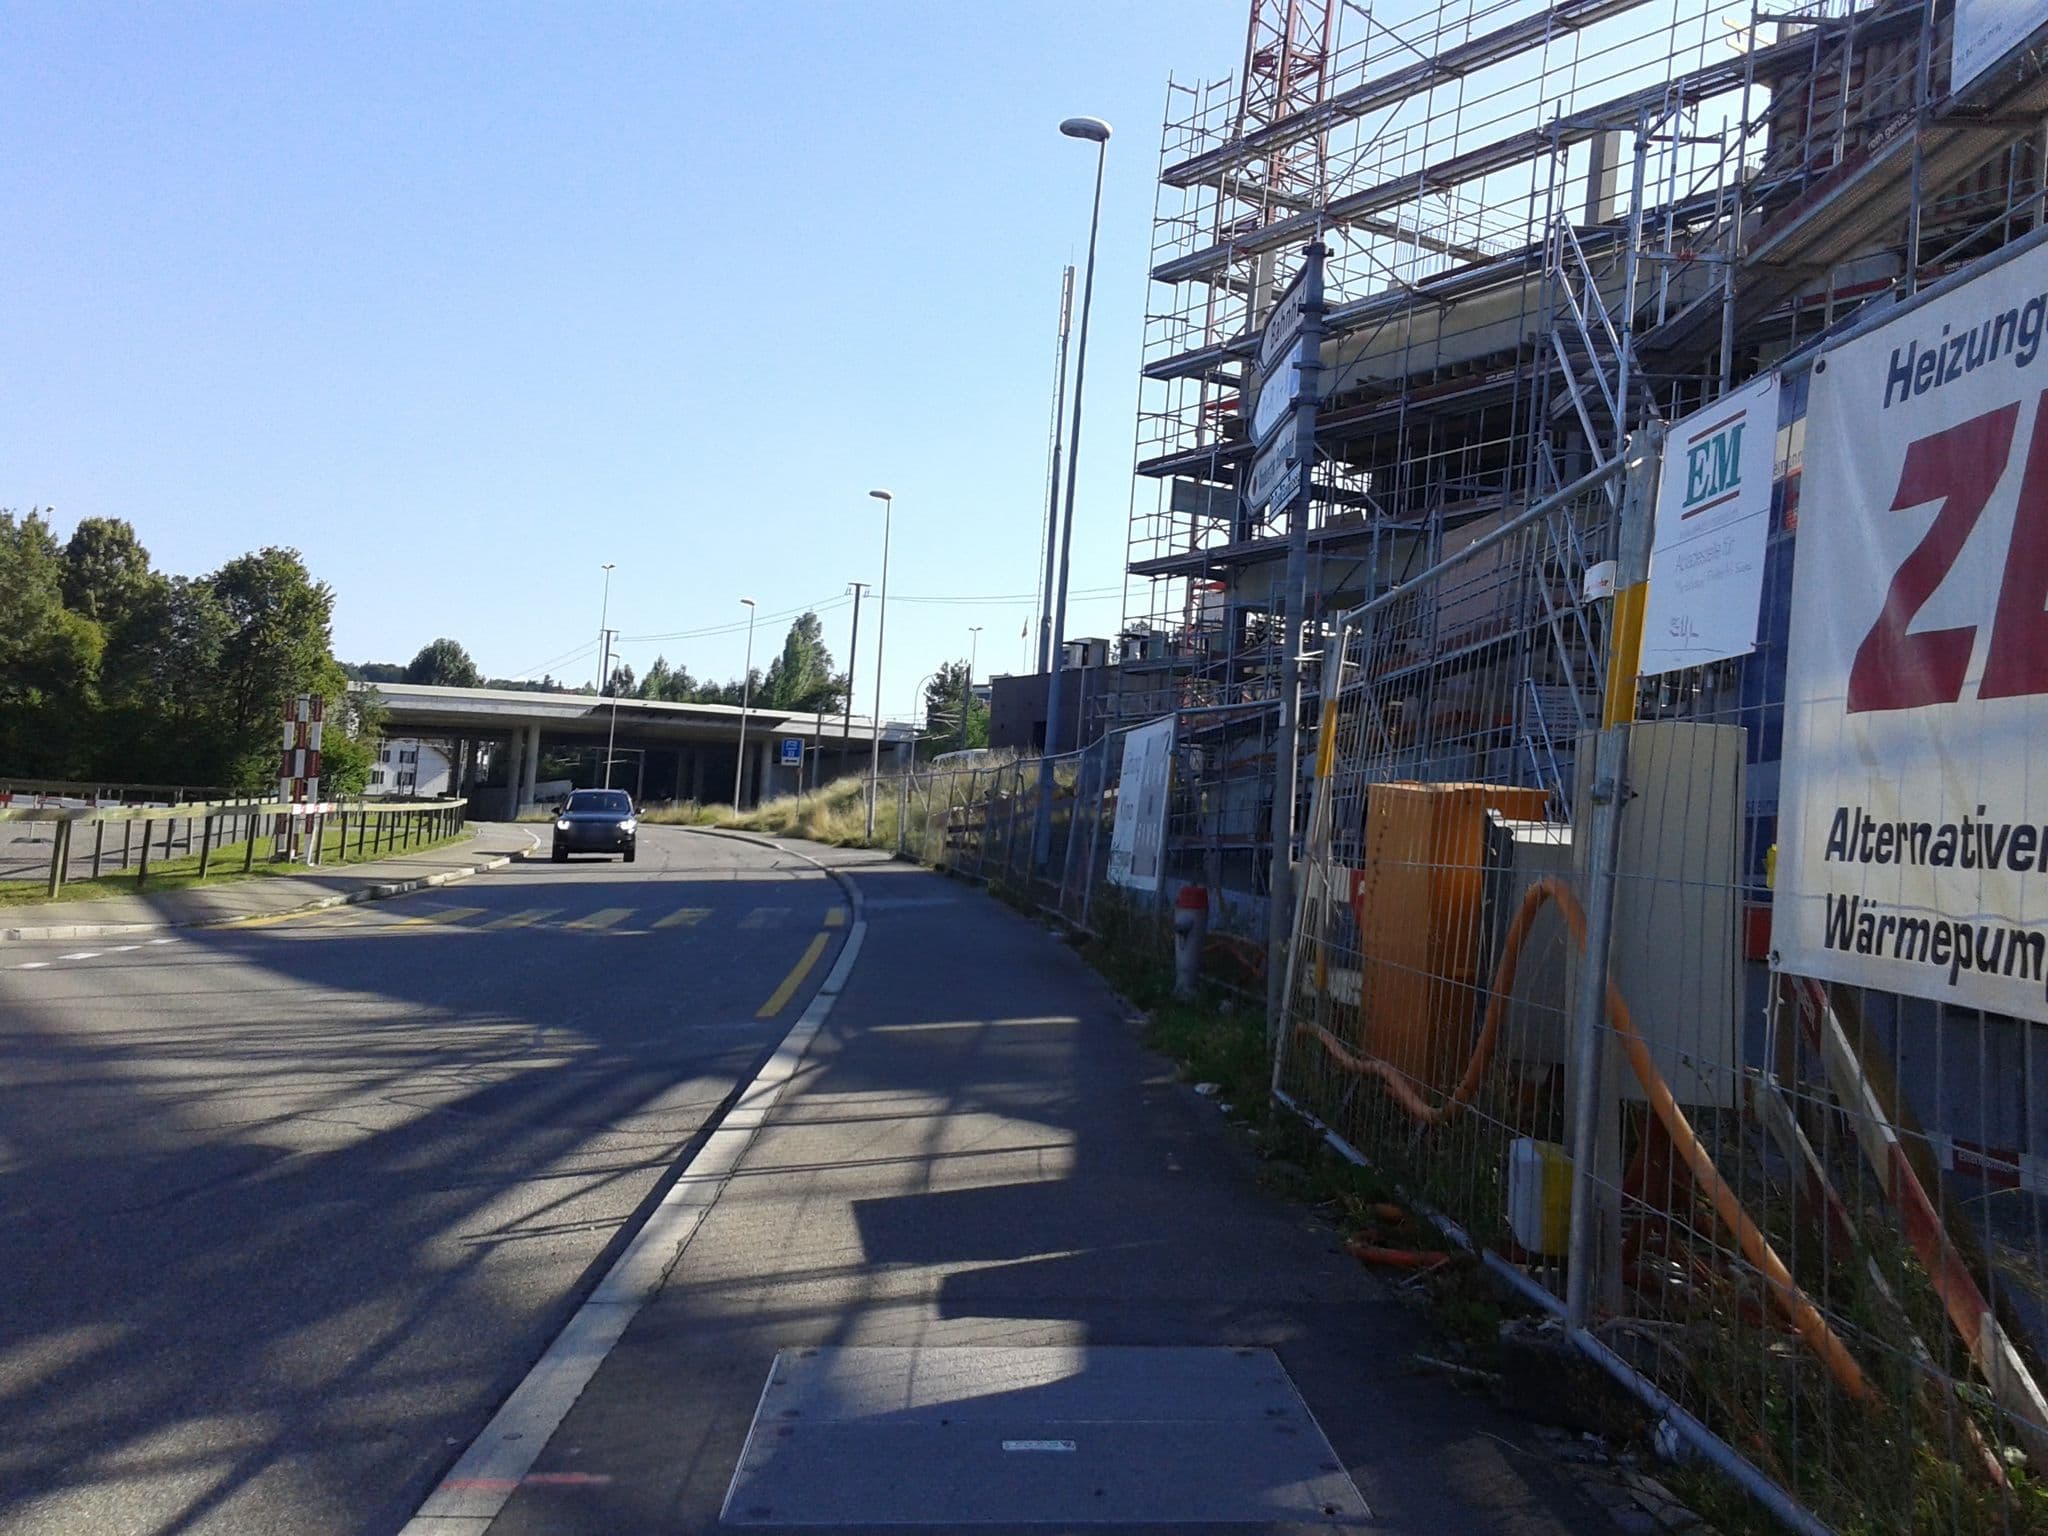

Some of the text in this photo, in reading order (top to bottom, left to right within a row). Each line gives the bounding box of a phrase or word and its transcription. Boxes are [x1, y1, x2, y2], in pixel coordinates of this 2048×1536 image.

[1883, 293, 2048, 409] Heizung
[1682, 423, 1746, 508] EM
[1824, 892, 2048, 1003] Wärmepum
